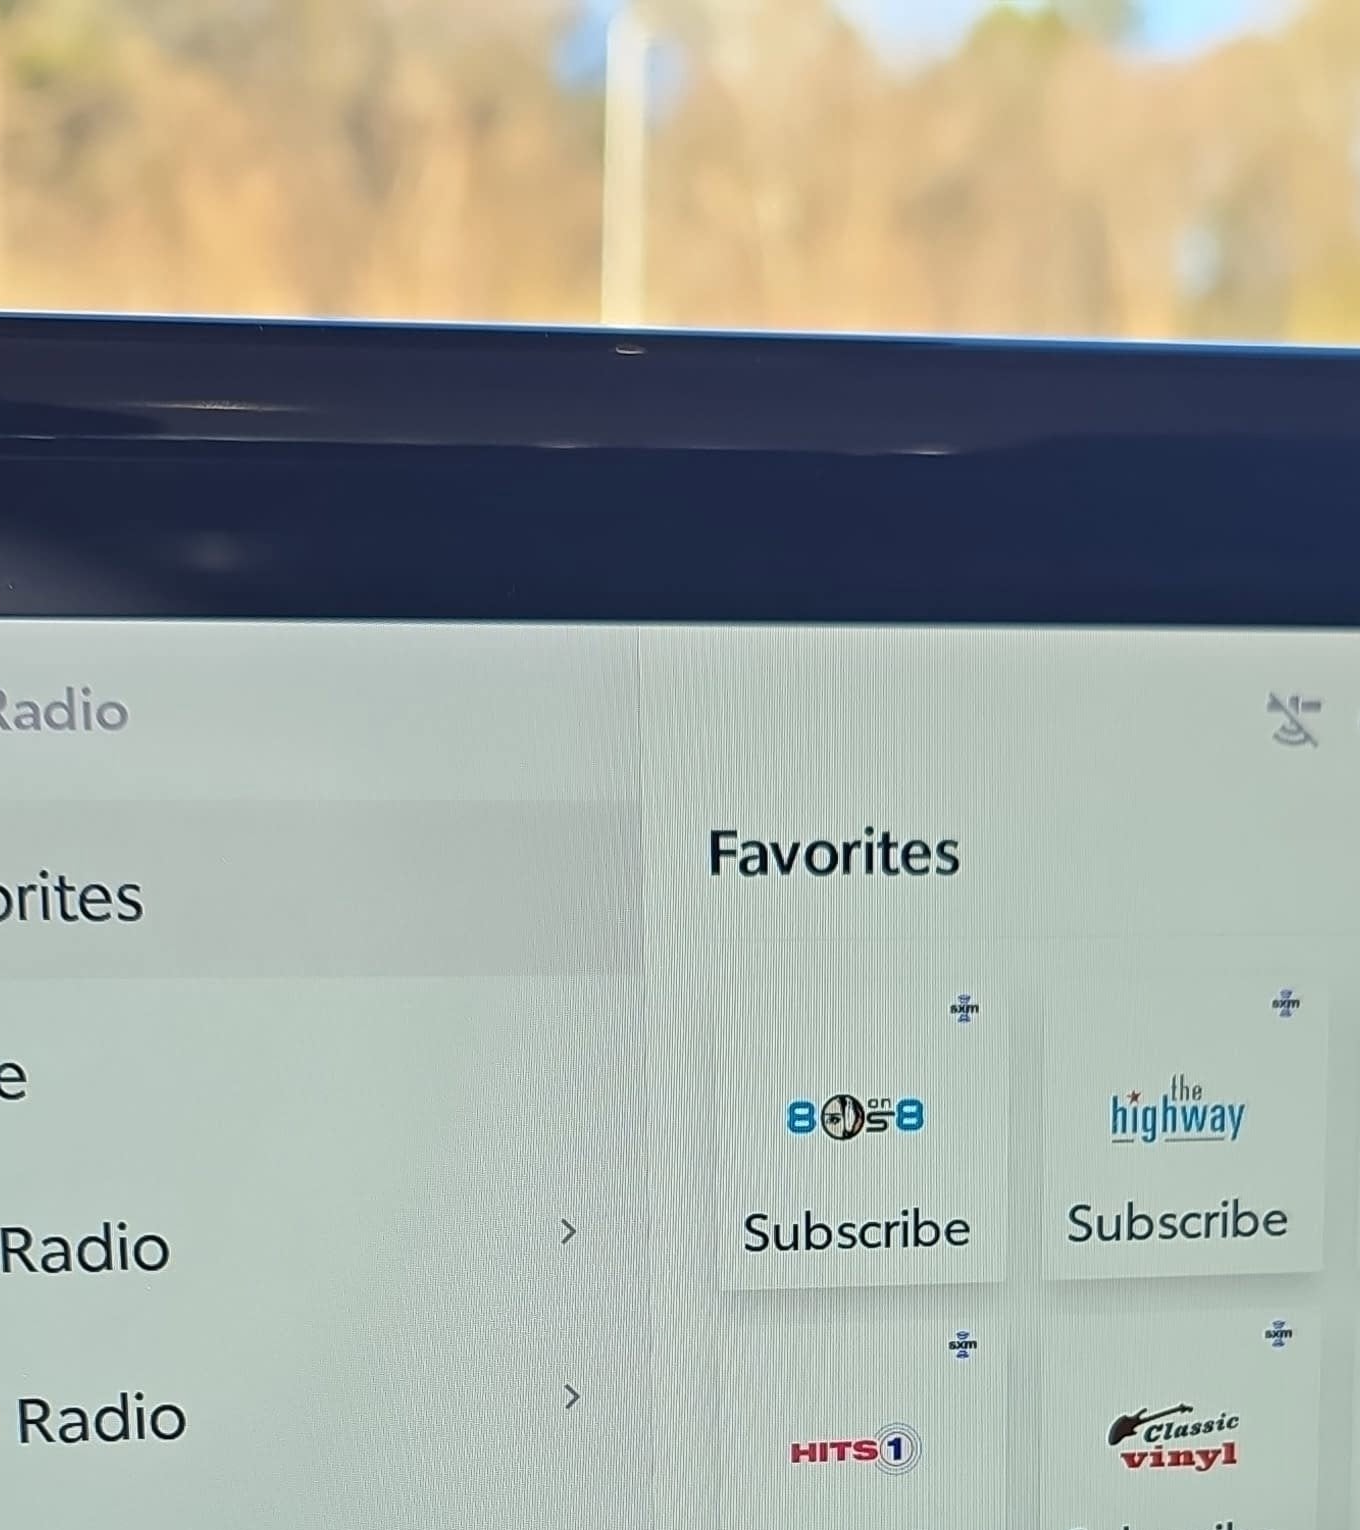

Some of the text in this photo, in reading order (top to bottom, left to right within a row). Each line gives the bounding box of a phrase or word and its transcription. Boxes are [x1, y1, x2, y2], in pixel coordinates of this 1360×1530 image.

[711, 827, 959, 876] Favorites
[1171, 1073, 1202, 1101] the
[1111, 1094, 1245, 1143] highway
[745, 1208, 970, 1251] Subscribe
[1069, 1199, 1287, 1242] Subscribe
[1, 1222, 169, 1273] Radio
[19, 1393, 185, 1443] Radio
[1143, 1413, 1240, 1443] Classic
[1120, 1442, 1237, 1471] vinyl
